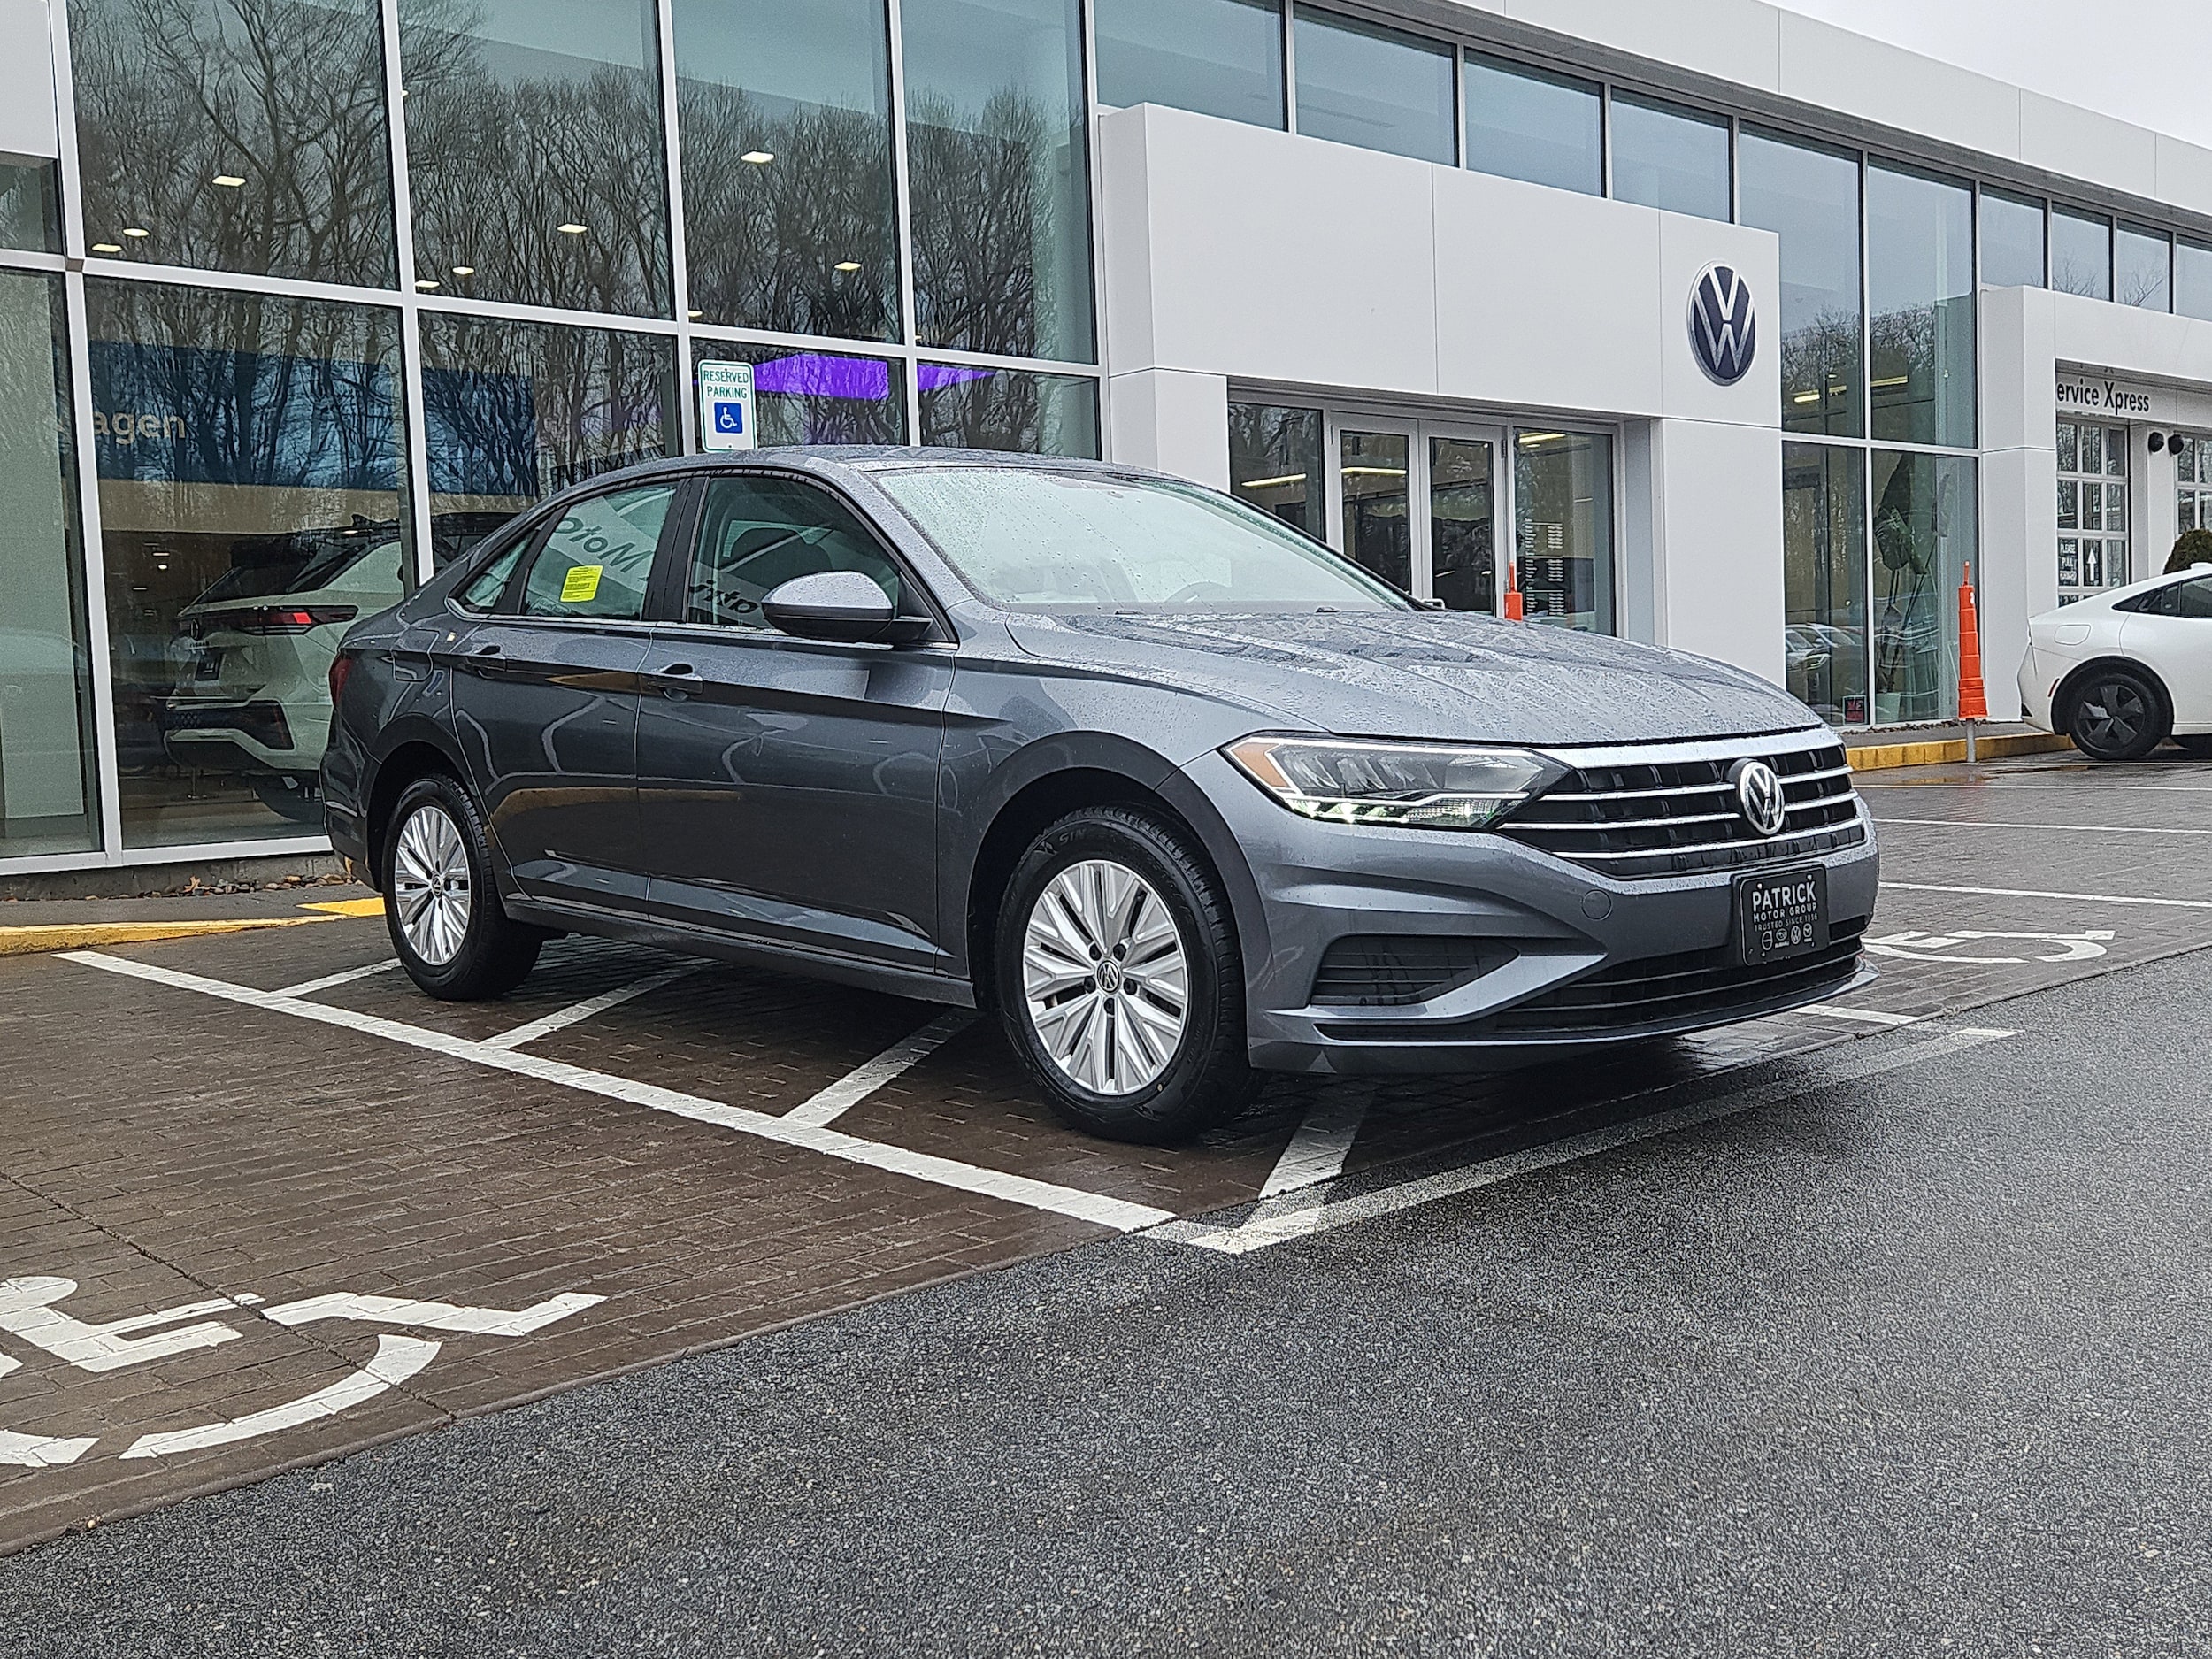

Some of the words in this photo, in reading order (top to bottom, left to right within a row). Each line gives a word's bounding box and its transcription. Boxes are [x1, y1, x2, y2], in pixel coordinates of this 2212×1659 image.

[703, 369, 749, 383] RESERVED
[707, 385, 748, 399] PARKING
[2056, 378, 2100, 406] ervice
[2104, 380, 2150, 416] Xpress
[93, 411, 186, 444] agen
[1752, 880, 1816, 912] PATRICK
[1753, 909, 1786, 923] MOTOR
[1789, 902, 1817, 916] GROUP
[1754, 920, 1783, 933] TRUSTED
[1786, 916, 1803, 926] SINCE
